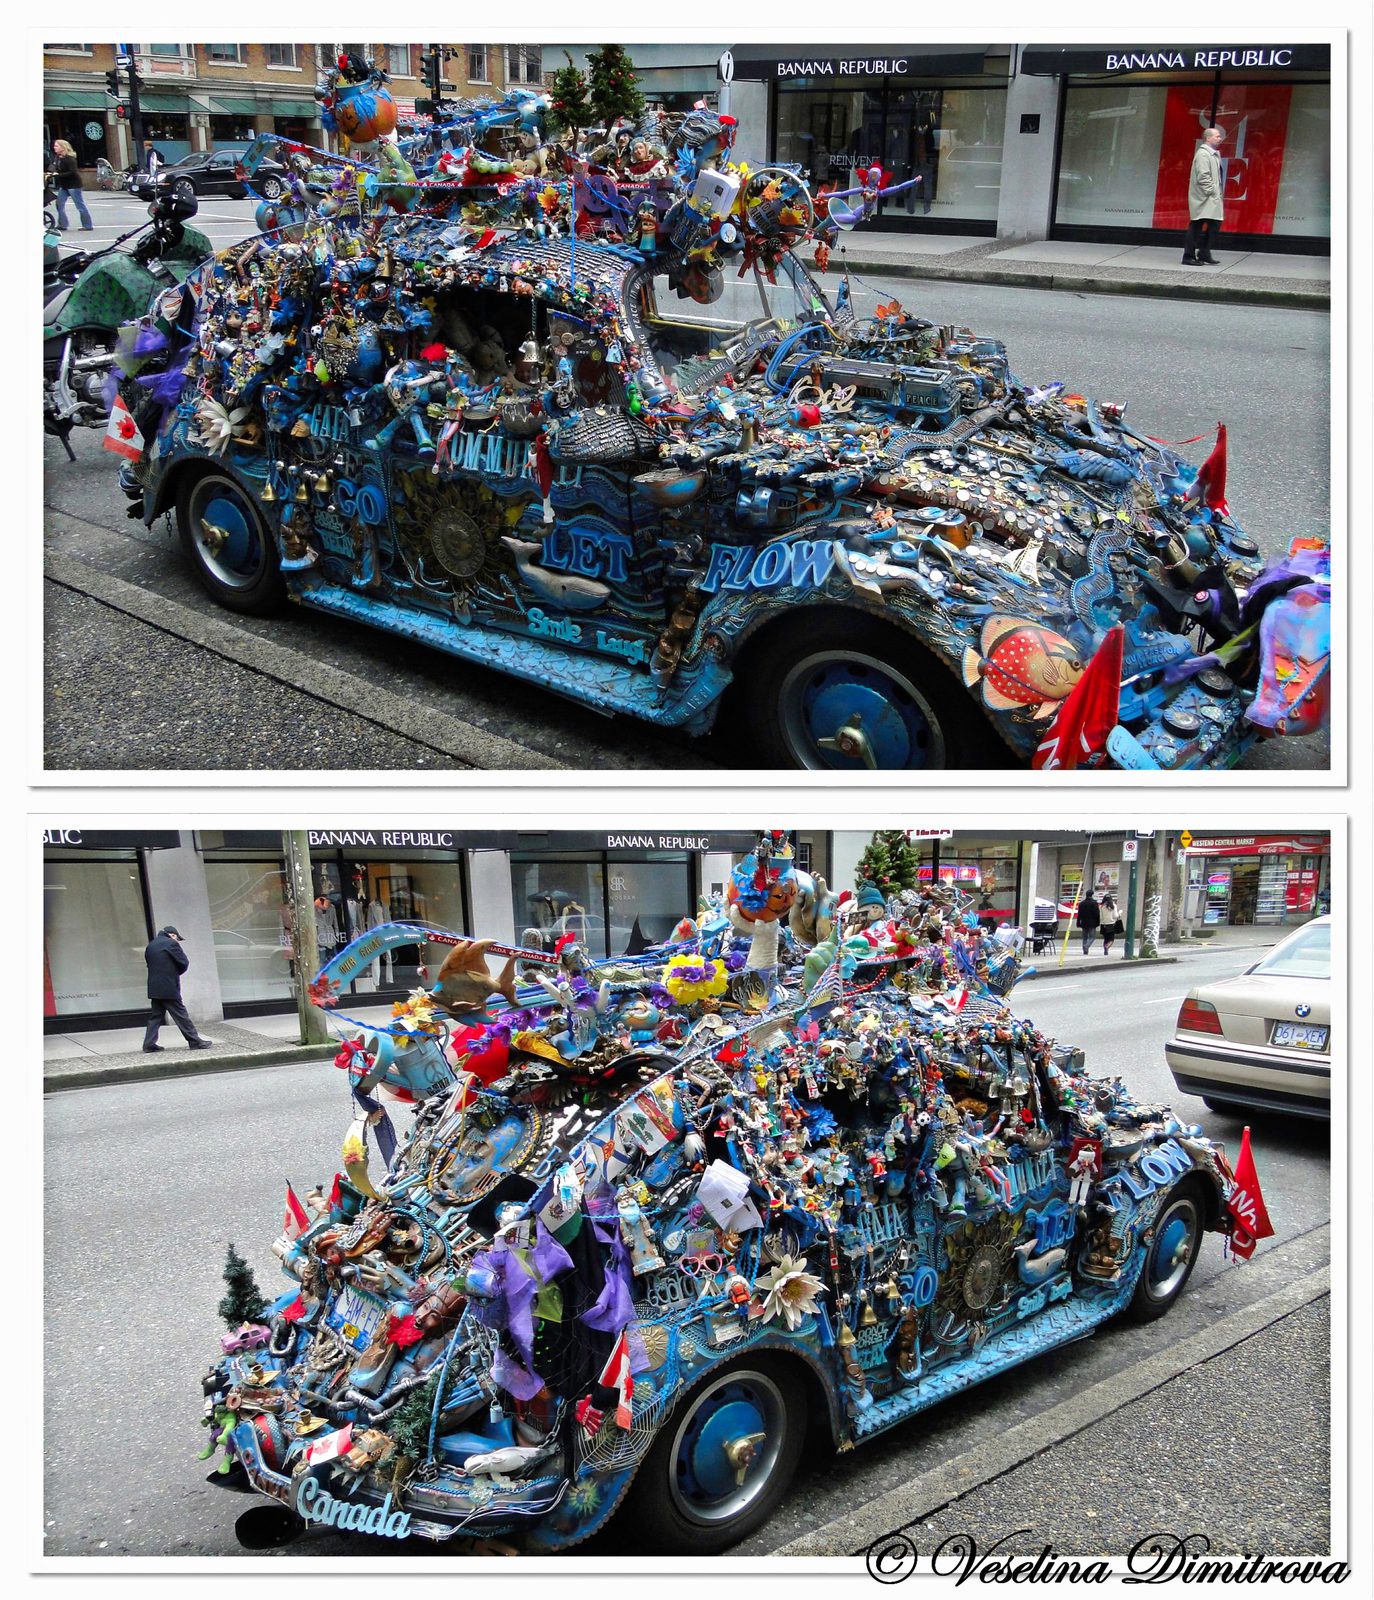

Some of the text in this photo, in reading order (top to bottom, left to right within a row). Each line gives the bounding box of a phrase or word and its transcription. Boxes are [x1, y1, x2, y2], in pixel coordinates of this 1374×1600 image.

[777, 60, 908, 76] BANANA REPUBLIC
[1106, 49, 1292, 70] BANANA REPUBLIC
[905, 394, 938, 407] PEACE
[336, 478, 387, 526] GO
[541, 524, 633, 582] LET
[700, 538, 847, 593] FLOW
[527, 607, 583, 644] Smile
[308, 831, 453, 847] BANANA REPUBLIC
[608, 835, 709, 850] BANANA REPUBLIC
[1192, 838, 1255, 847] WESTEND CENTRAL MARKET
[1034, 1203, 1077, 1255] LET
[297, 1477, 412, 1539] Canada
